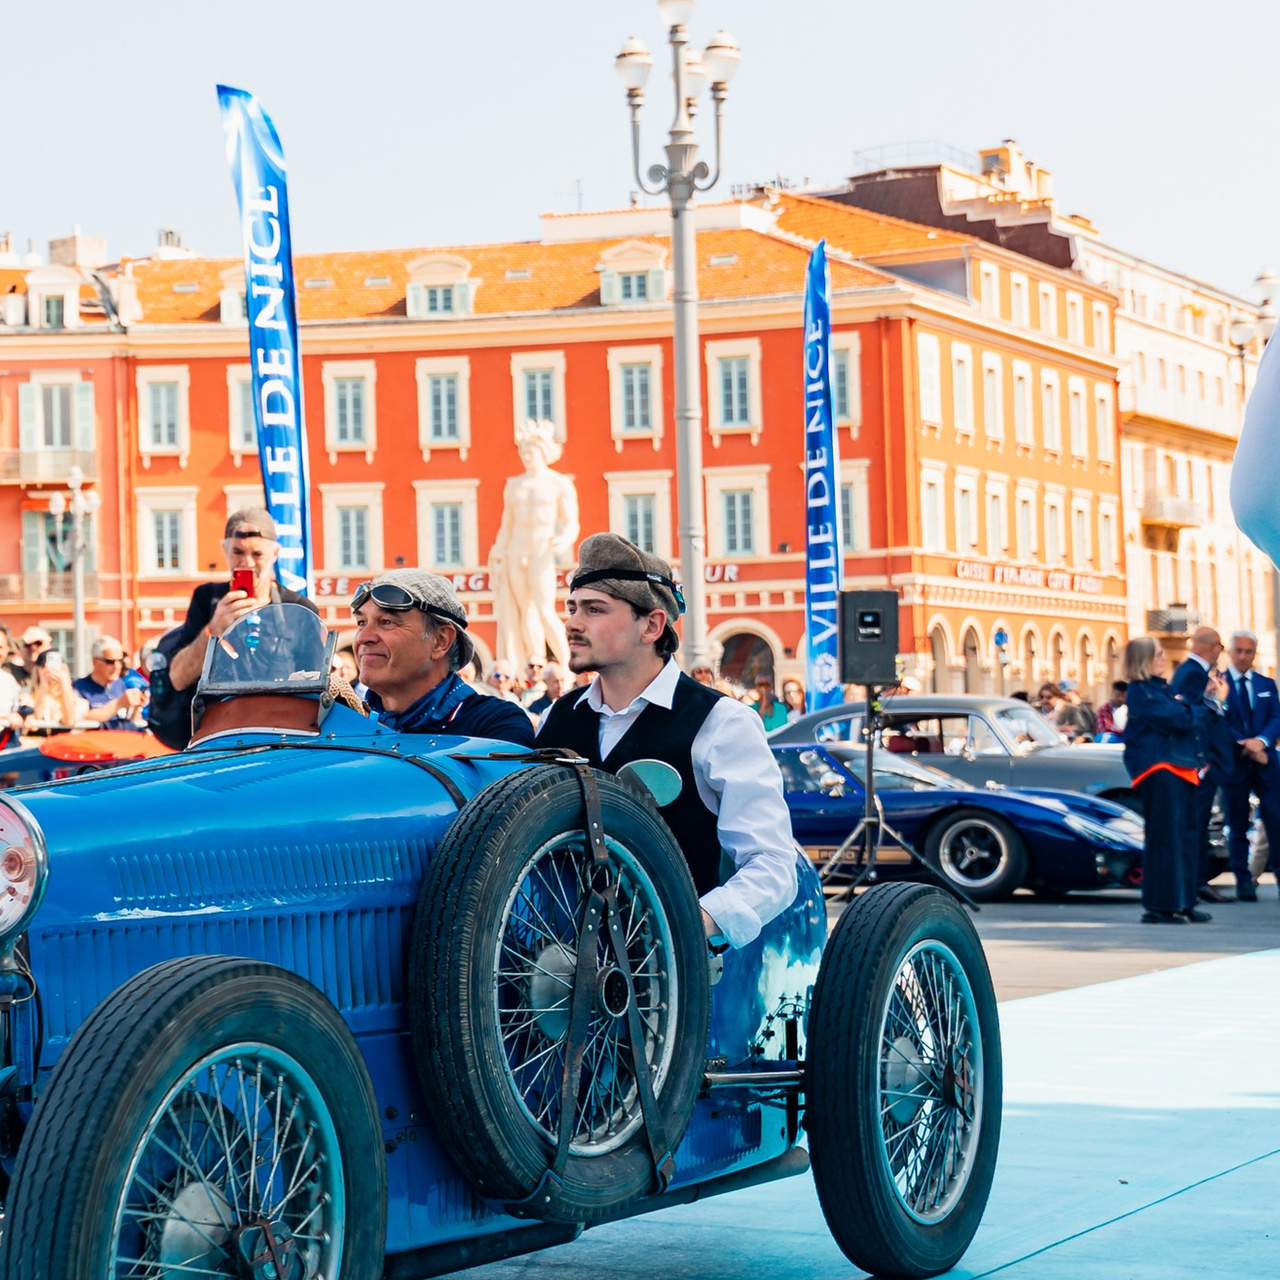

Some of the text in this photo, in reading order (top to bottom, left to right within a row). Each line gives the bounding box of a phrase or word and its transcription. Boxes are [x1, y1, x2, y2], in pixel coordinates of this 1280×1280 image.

[257, 347, 295, 430] DE
[265, 446, 308, 592] VILLE
[805, 319, 838, 646] VILLE DE NICE
